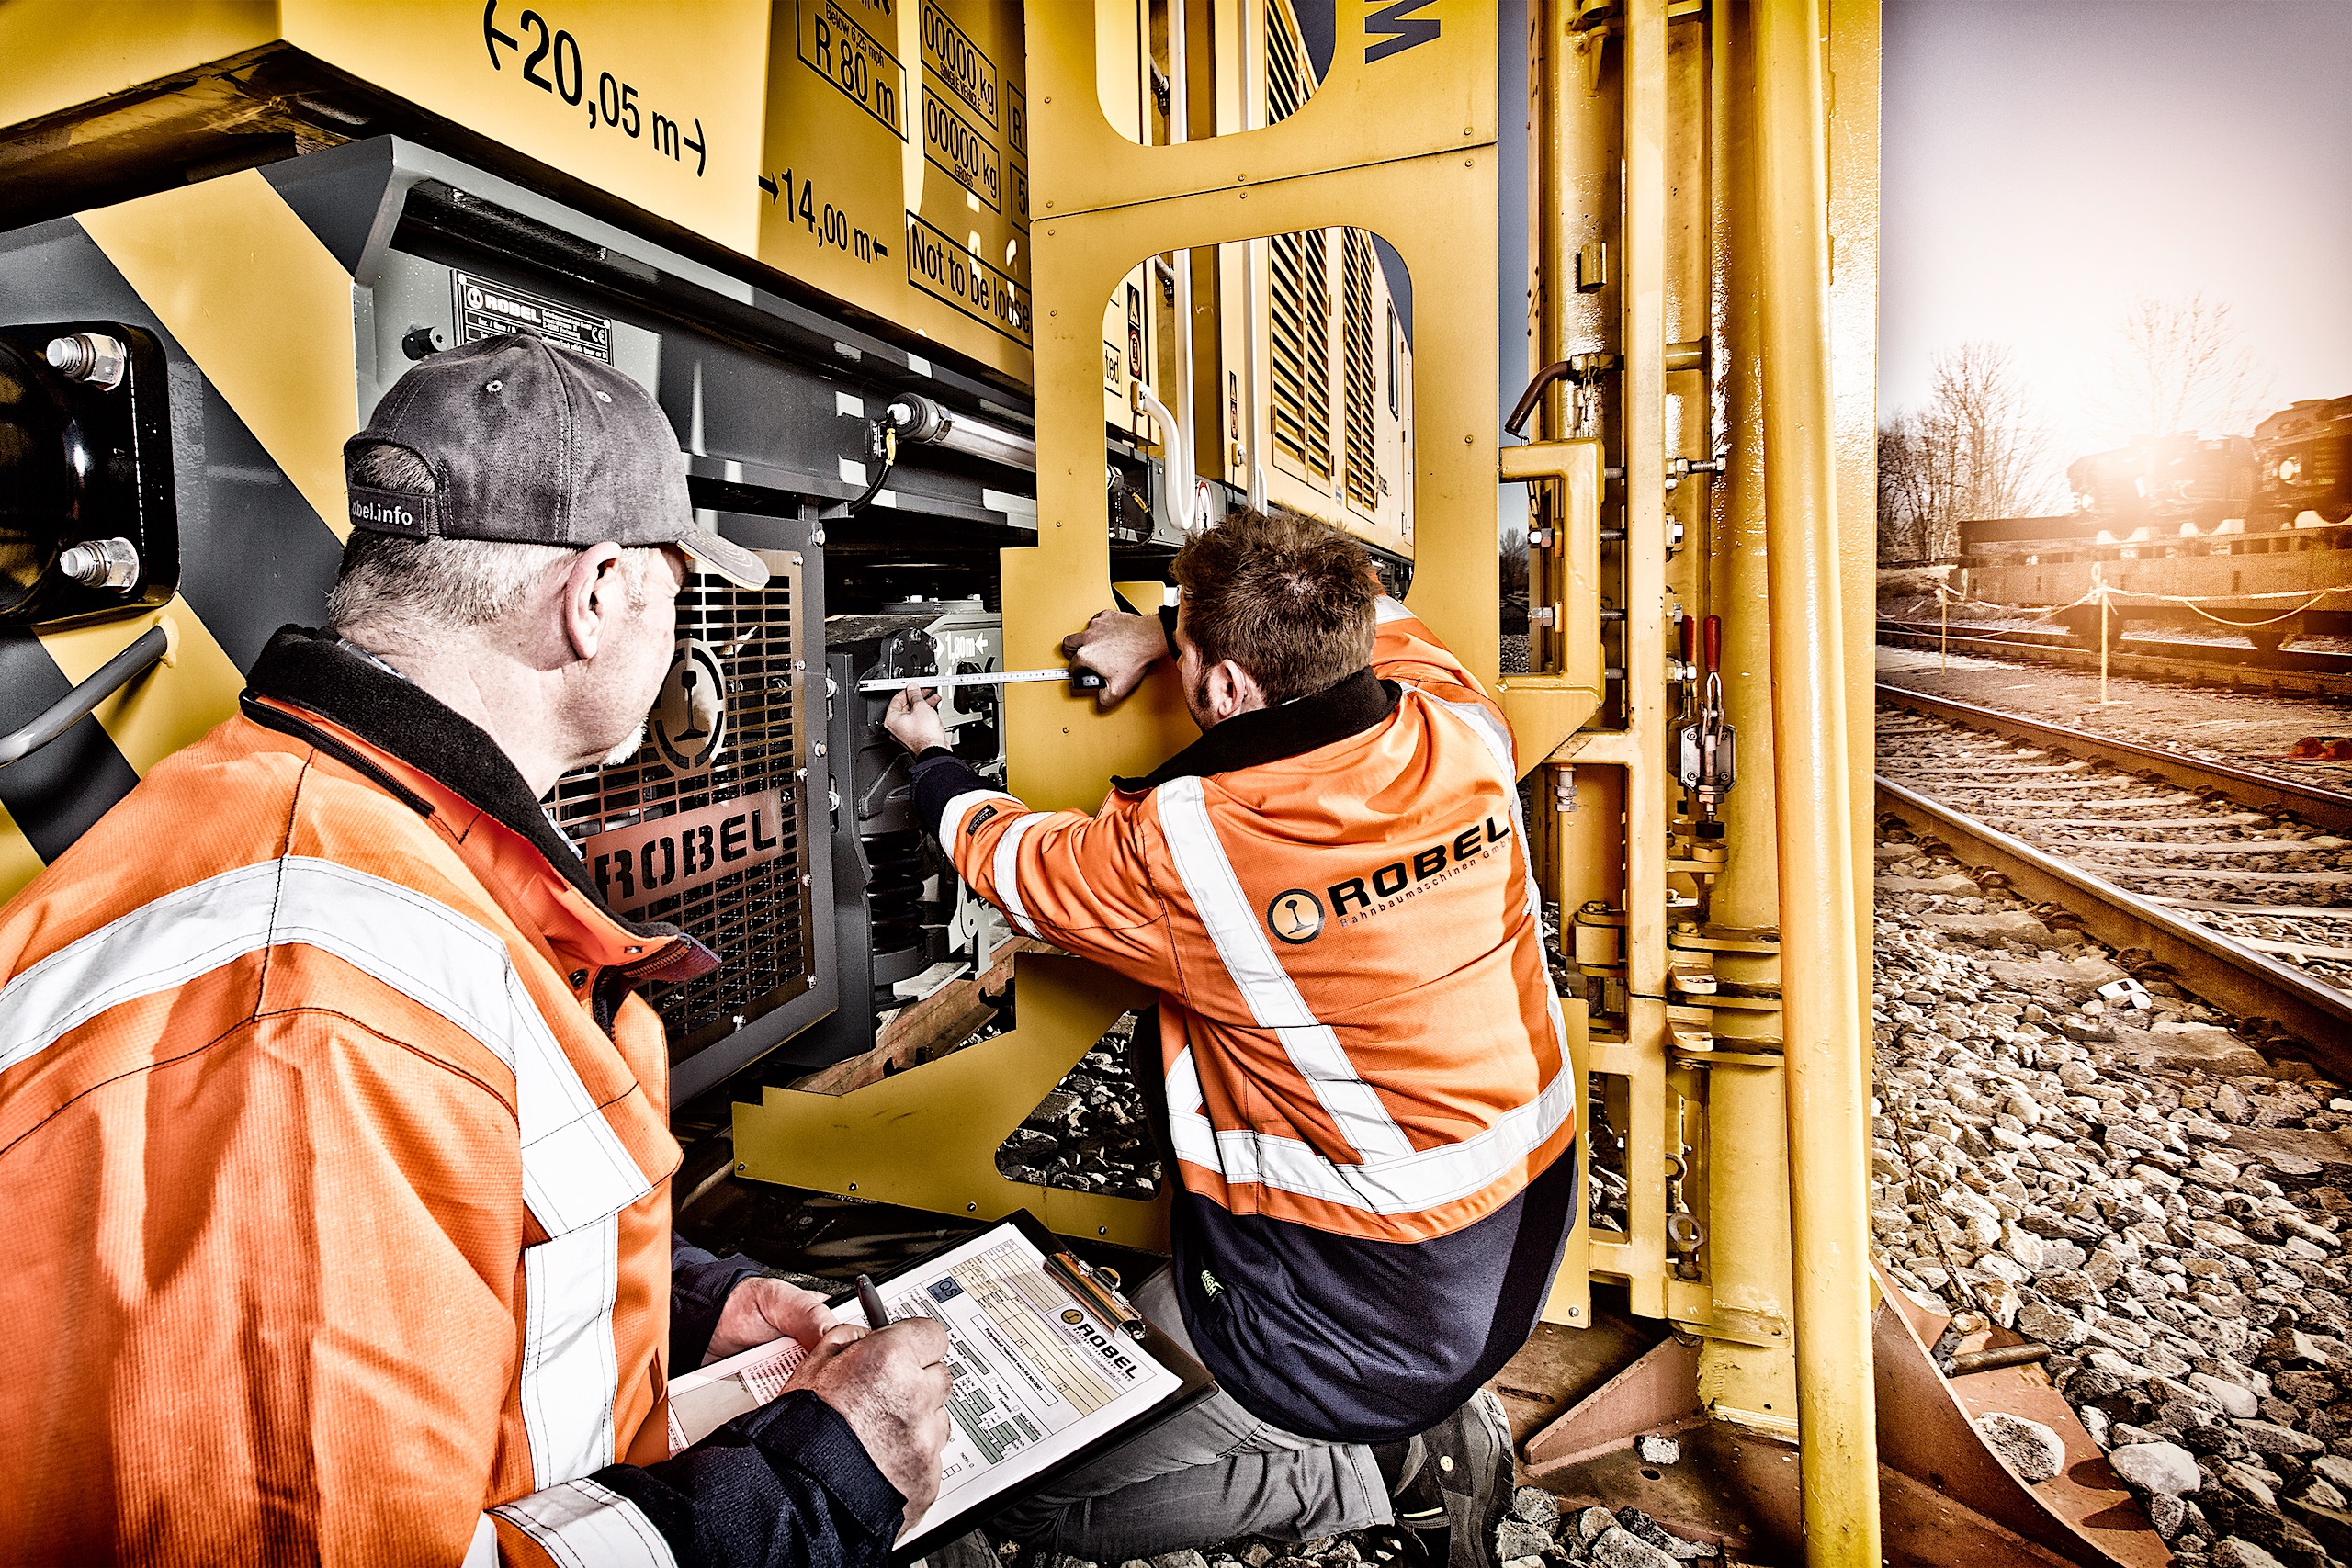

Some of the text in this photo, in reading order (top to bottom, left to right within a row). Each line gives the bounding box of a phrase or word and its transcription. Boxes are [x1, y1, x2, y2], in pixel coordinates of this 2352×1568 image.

[826, 3, 849, 37] Below
[869, 45, 884, 68] mph
[924, 6, 994, 115] 00000 kg
[521, 9, 680, 162] 20,05 m
[814, 13, 895, 126] R 80 m
[940, 62, 959, 91] SINGLE
[927, 99, 997, 198] 00000 kg
[956, 164, 973, 187] GROSS
[782, 168, 871, 264] 14,00 m
[1019, 177, 1027, 215] 5
[911, 223, 945, 286] Not
[947, 248, 965, 297] to
[969, 263, 989, 311] be
[485, 294, 542, 324] ROBEL
[1104, 350, 1119, 384] ted
[352, 500, 413, 525] obel.info
[594, 808, 777, 905] ROBEL
[1327, 817, 1510, 918] ROBEL
[1340, 858, 1476, 928] Bahnbaumaschinen
[939, 1280, 957, 1297] QS
[1077, 1323, 1137, 1379] ROBEL
